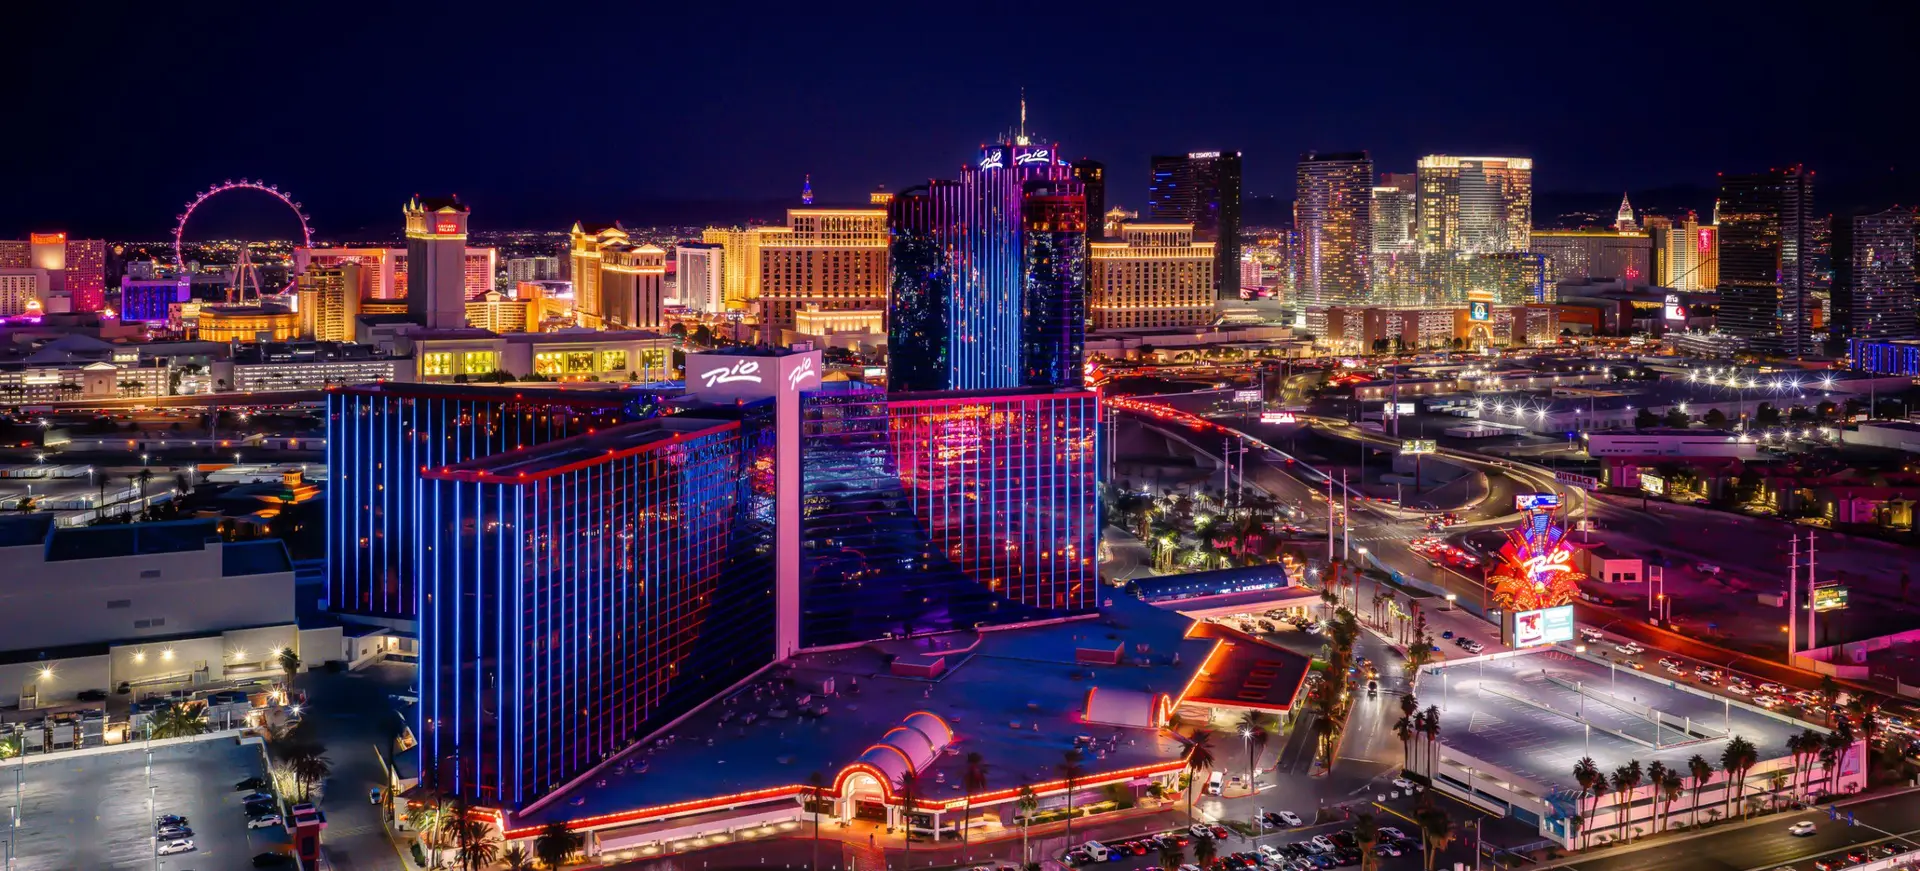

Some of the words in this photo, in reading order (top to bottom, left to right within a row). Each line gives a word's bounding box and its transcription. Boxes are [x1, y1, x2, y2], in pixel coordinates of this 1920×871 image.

[980, 151, 1003, 172] Rio
[1015, 149, 1050, 165] Rio
[701, 359, 762, 388] Rio
[788, 357, 815, 391] Rio
[1556, 471, 1593, 485] OUTBACK
[1523, 547, 1571, 578] Rio
